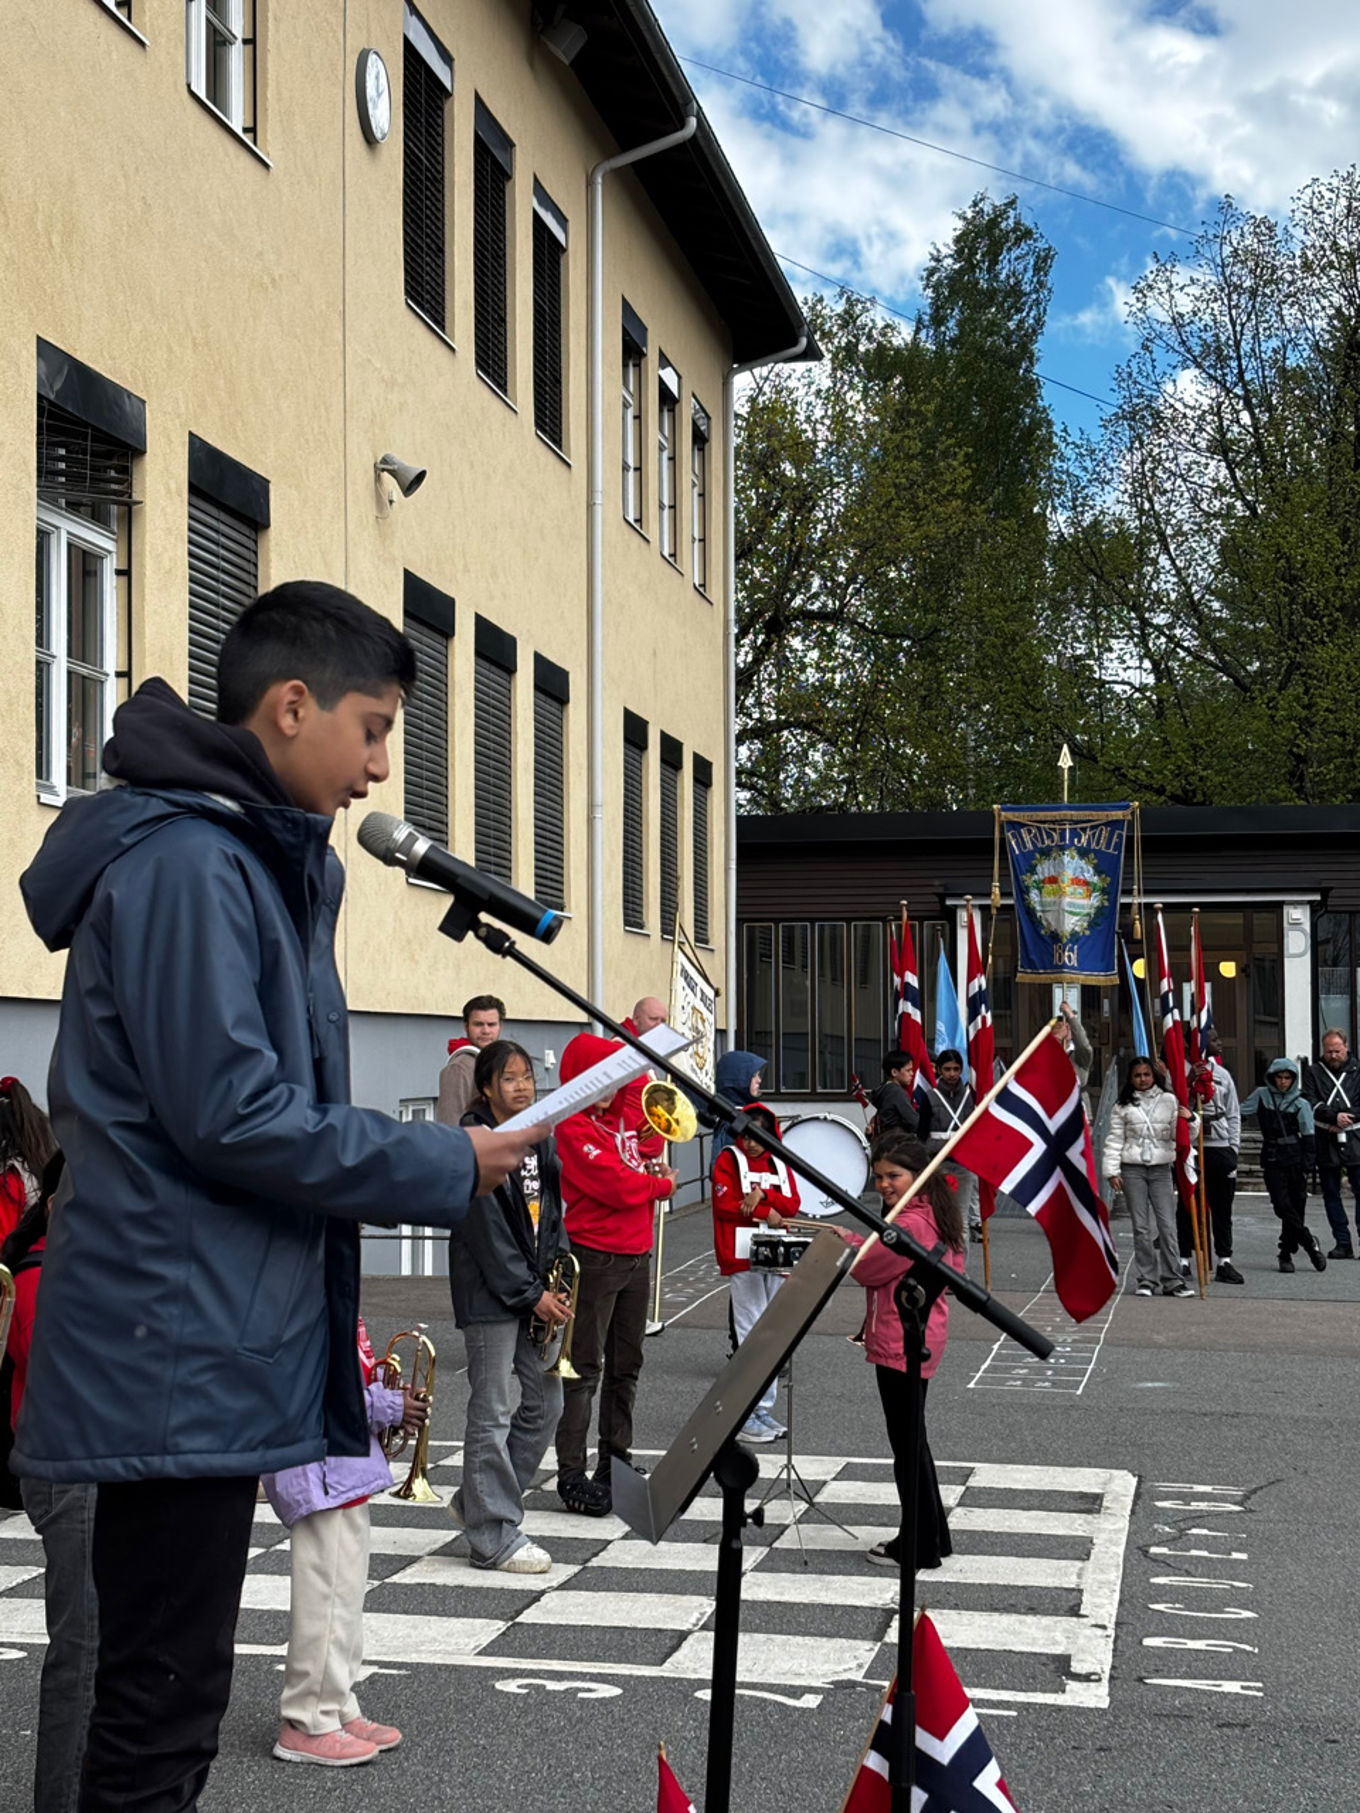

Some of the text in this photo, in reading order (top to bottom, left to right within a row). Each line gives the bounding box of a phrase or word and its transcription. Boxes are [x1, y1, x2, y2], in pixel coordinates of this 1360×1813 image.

[1007, 823, 1125, 855] FURUSET SKOLE
[1285, 926, 1310, 958] D
[1053, 944, 1078, 968] 1861
[494, 1677, 624, 1700] 3
[1143, 1678, 1264, 1697] A
